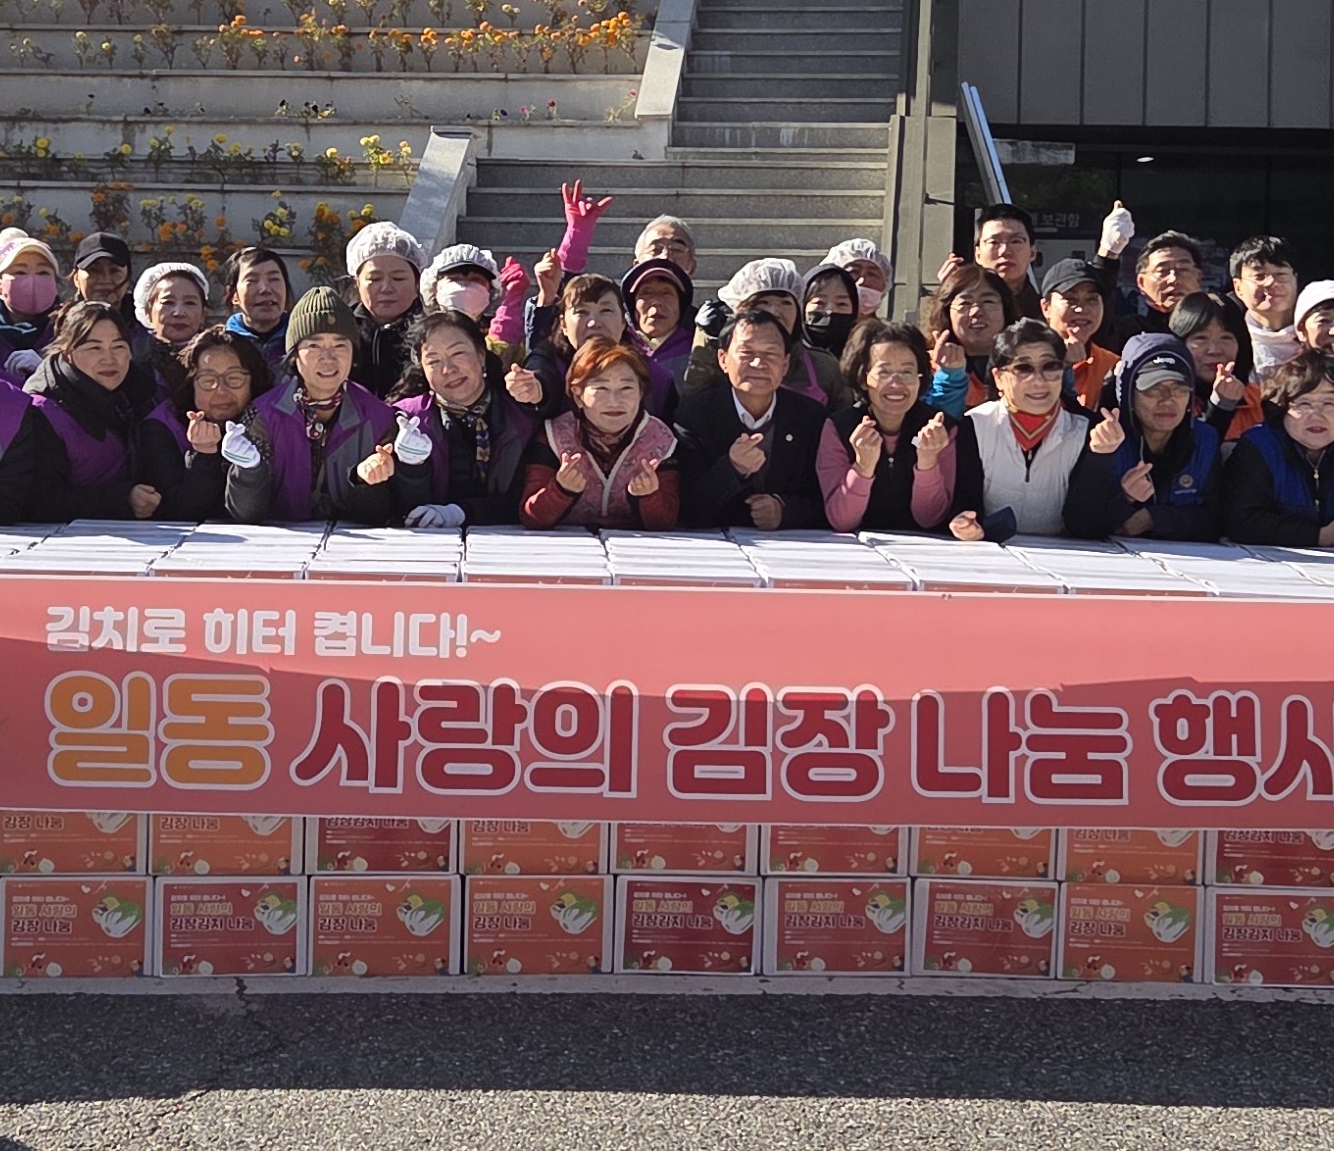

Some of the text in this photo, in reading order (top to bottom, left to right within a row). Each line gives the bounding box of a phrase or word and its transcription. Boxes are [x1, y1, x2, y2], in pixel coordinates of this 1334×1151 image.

[45, 605, 502, 659] 김치로 히터 켭니다!~
[44, 670, 275, 792] 일동
[288, 675, 639, 799] 사랑의
[663, 682, 894, 802] 김장
[910, 686, 1133, 806] 나눔
[3, 815, 64, 830] 김장 나눔
[160, 817, 220, 831] 김장 나눔
[11, 919, 72, 934] 김장 나눔
[170, 917, 254, 931] 김장김치 나눔
[318, 918, 377, 932] 김장 나눔
[473, 916, 531, 930] 김장 나눔
[632, 914, 683, 928] 김장김치
[784, 915, 865, 929] 김장김치 나눔
[934, 915, 1013, 933] 김장김치 나눔
[1069, 921, 1126, 937] 김장 나눔
[1222, 927, 1273, 941] 김장김치
